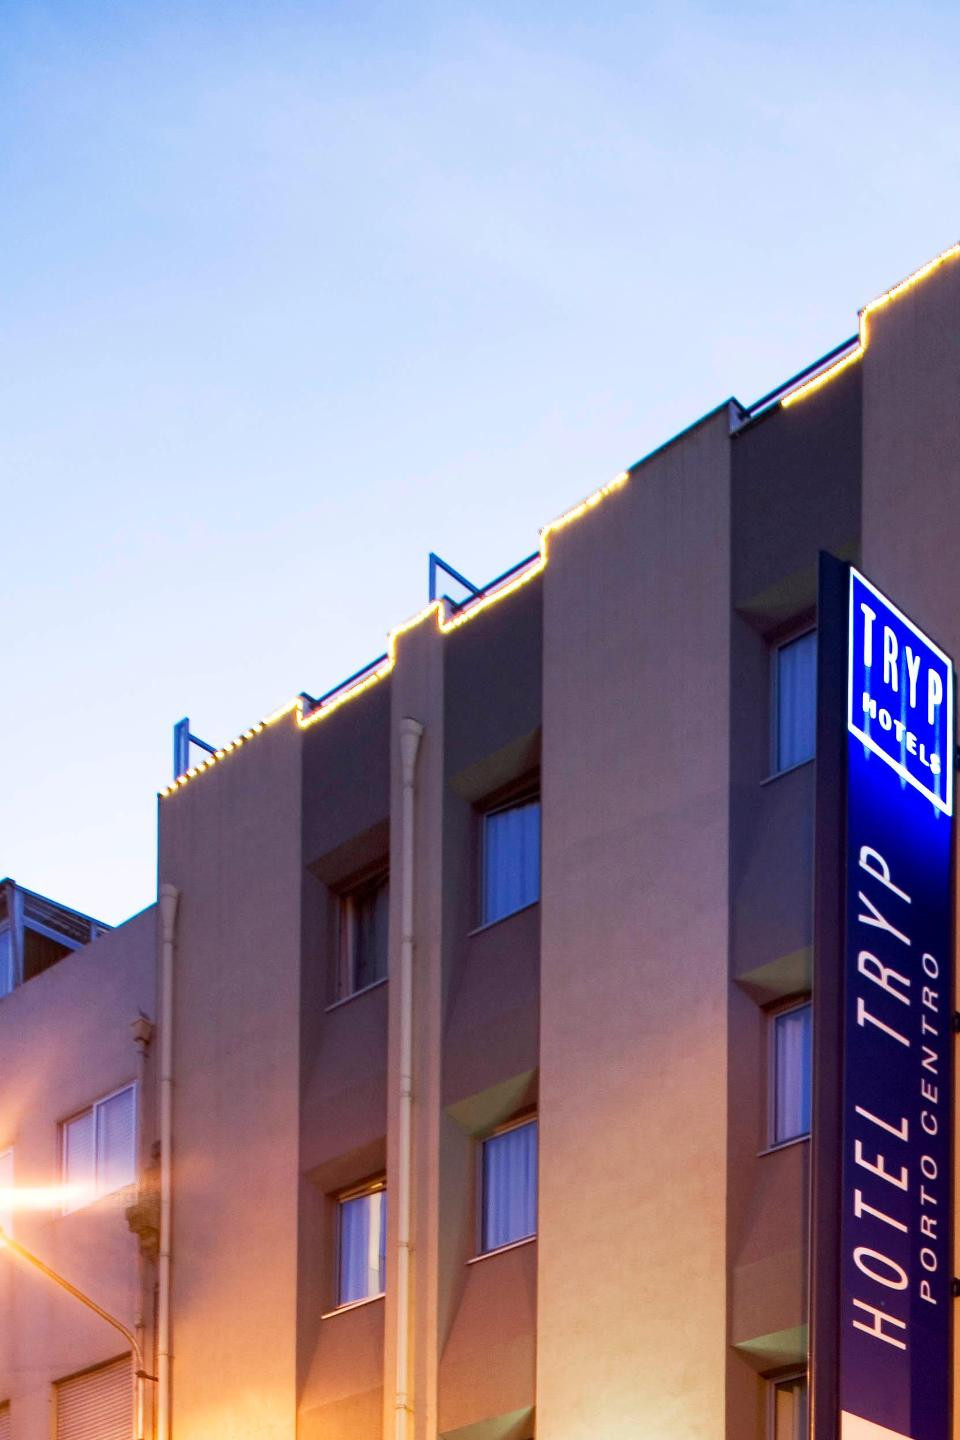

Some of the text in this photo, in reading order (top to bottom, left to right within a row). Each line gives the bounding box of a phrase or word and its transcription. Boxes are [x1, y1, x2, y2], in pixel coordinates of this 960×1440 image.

[861, 602, 943, 725] TRYP
[862, 692, 942, 775] HOTELS
[853, 845, 912, 1351] HOTEL TRYP
[920, 953, 939, 1305] PORTO CENTRO
